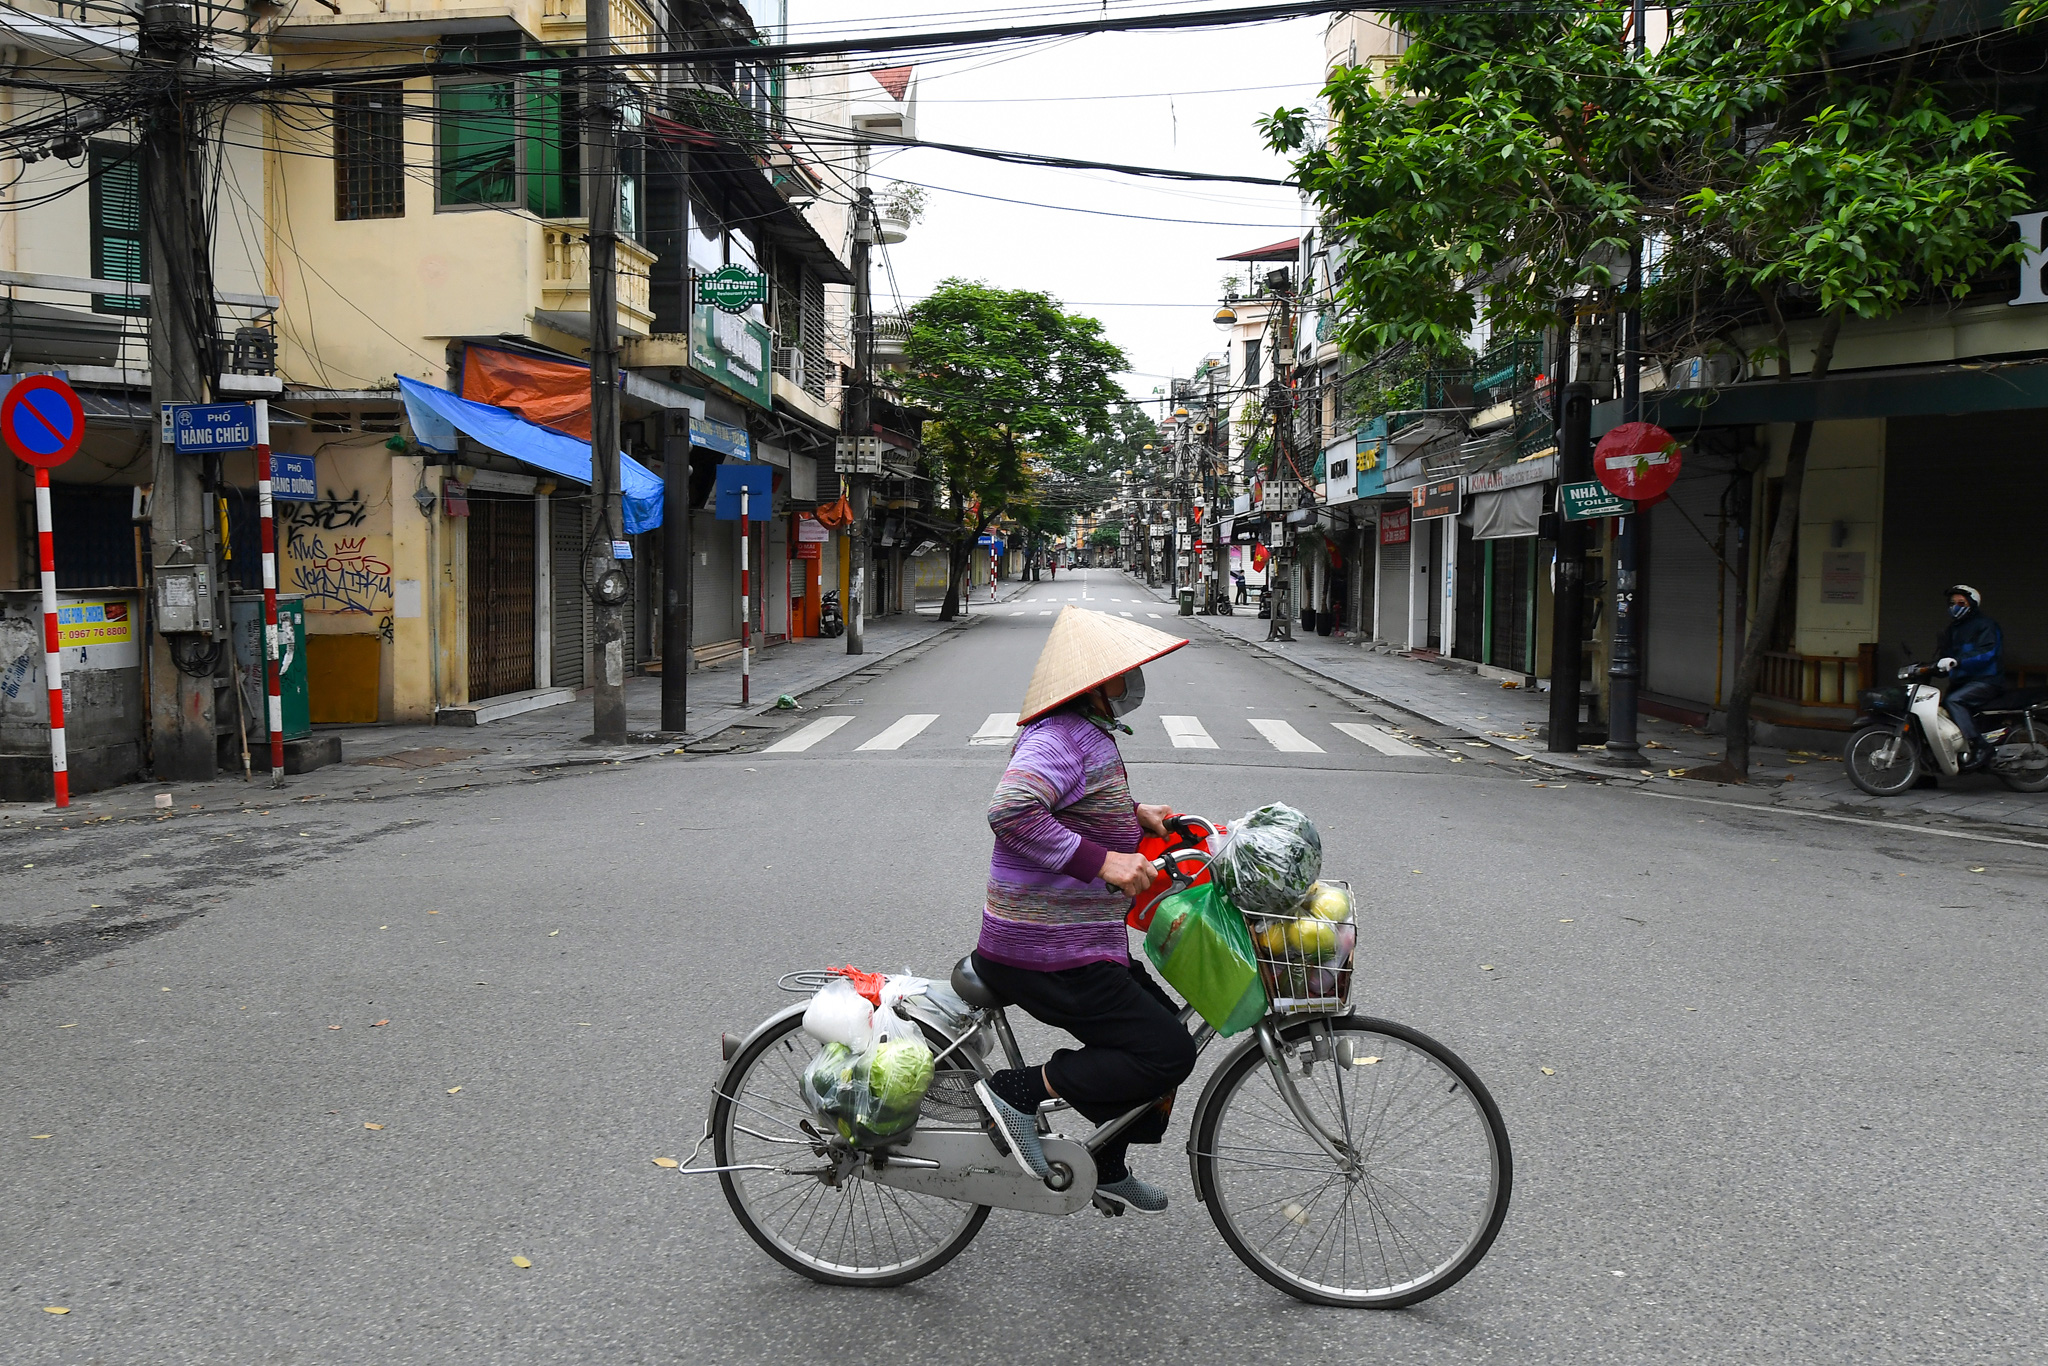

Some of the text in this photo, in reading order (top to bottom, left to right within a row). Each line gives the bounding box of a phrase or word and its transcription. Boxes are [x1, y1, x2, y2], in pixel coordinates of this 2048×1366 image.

[704, 280, 758, 290] OldTown
[208, 410, 231, 422] PHỐ
[181, 426, 213, 445] HÀNG
[216, 422, 249, 443] CHIẾU
[287, 462, 301, 472] PHỐ
[271, 474, 314, 494] HÀNG ĐƯỜNG
[1472, 475, 1486, 491] KIM
[1488, 471, 1503, 488] ANH
[1570, 485, 1598, 499] NHÀ
[1575, 497, 1619, 506] TOILET
[313, 556, 390, 575] LOTUS
[69, 630, 90, 639] 0967
[93, 628, 104, 636] 76
[106, 627, 127, 636] 8800
